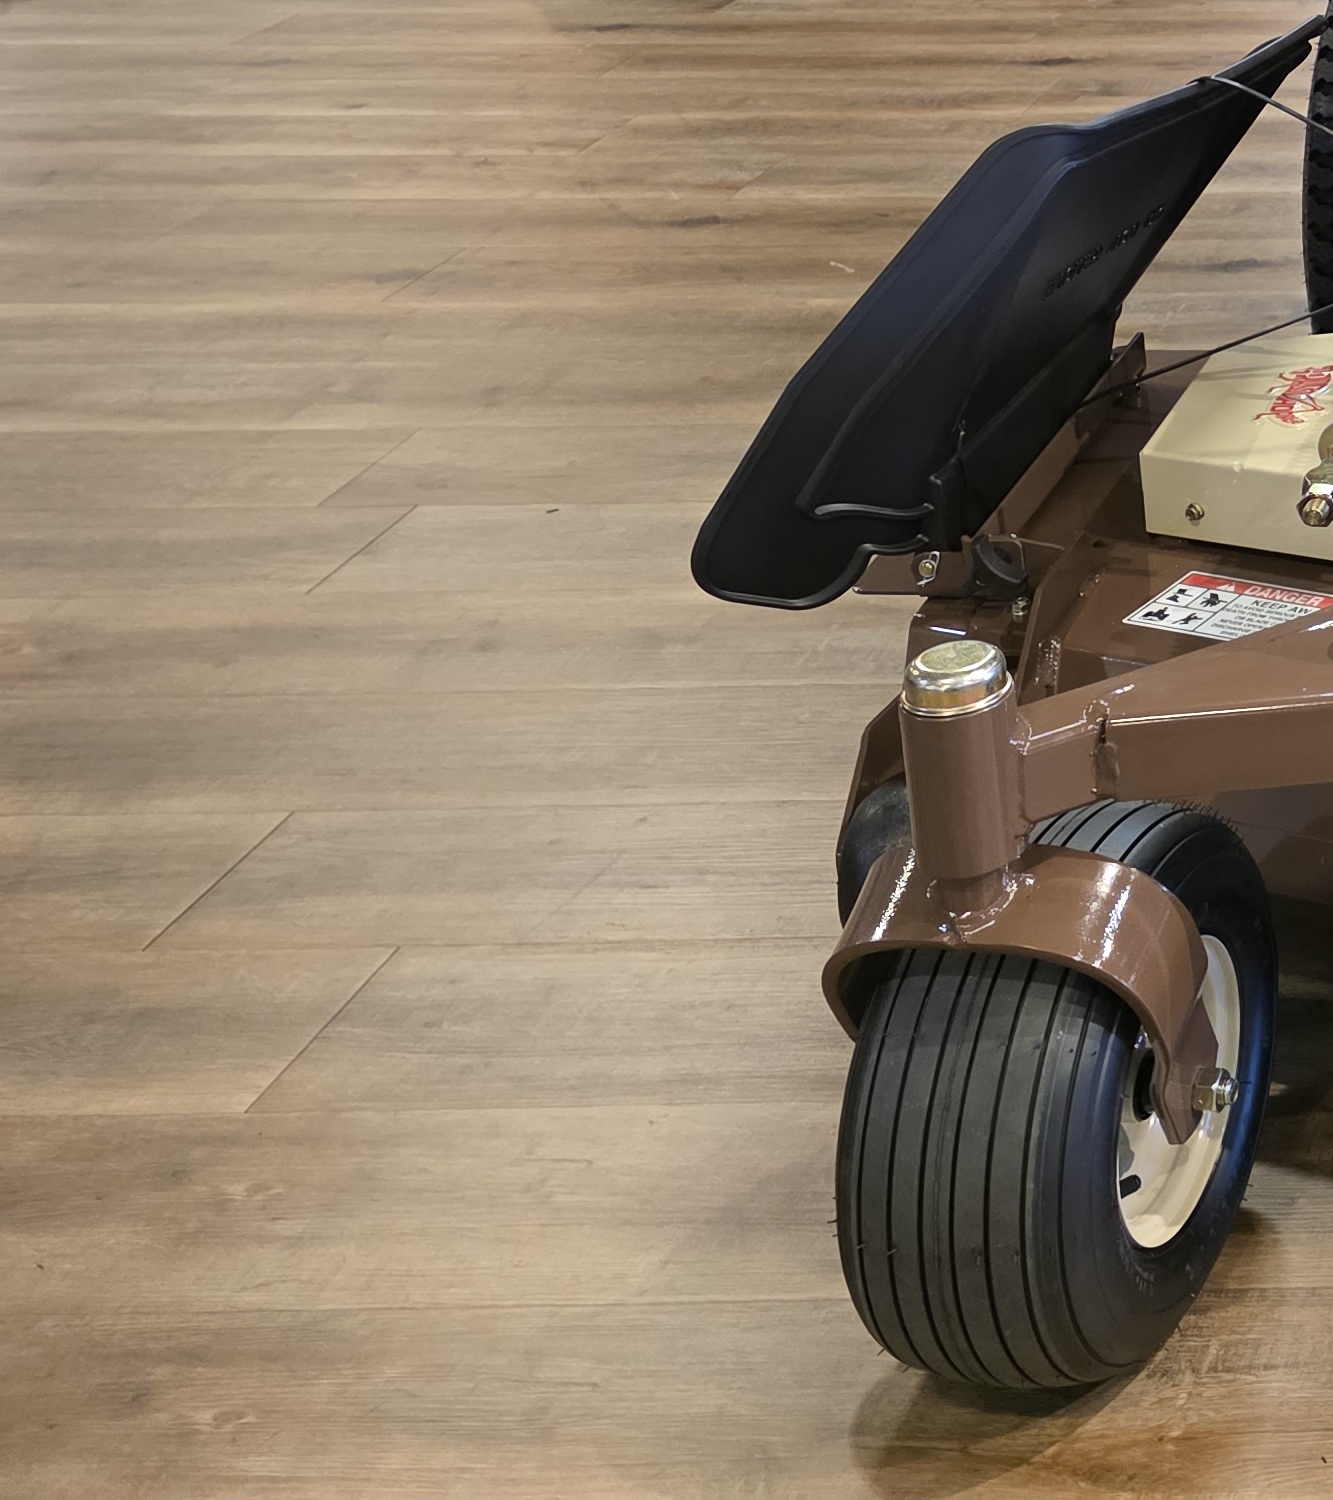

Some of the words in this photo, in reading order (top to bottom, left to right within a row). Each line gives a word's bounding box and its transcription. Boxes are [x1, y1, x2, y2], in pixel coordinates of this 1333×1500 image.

[1243, 585, 1325, 607] DANGER
[1250, 599, 1288, 610] KEEP
[1288, 606, 1313, 614] AW
